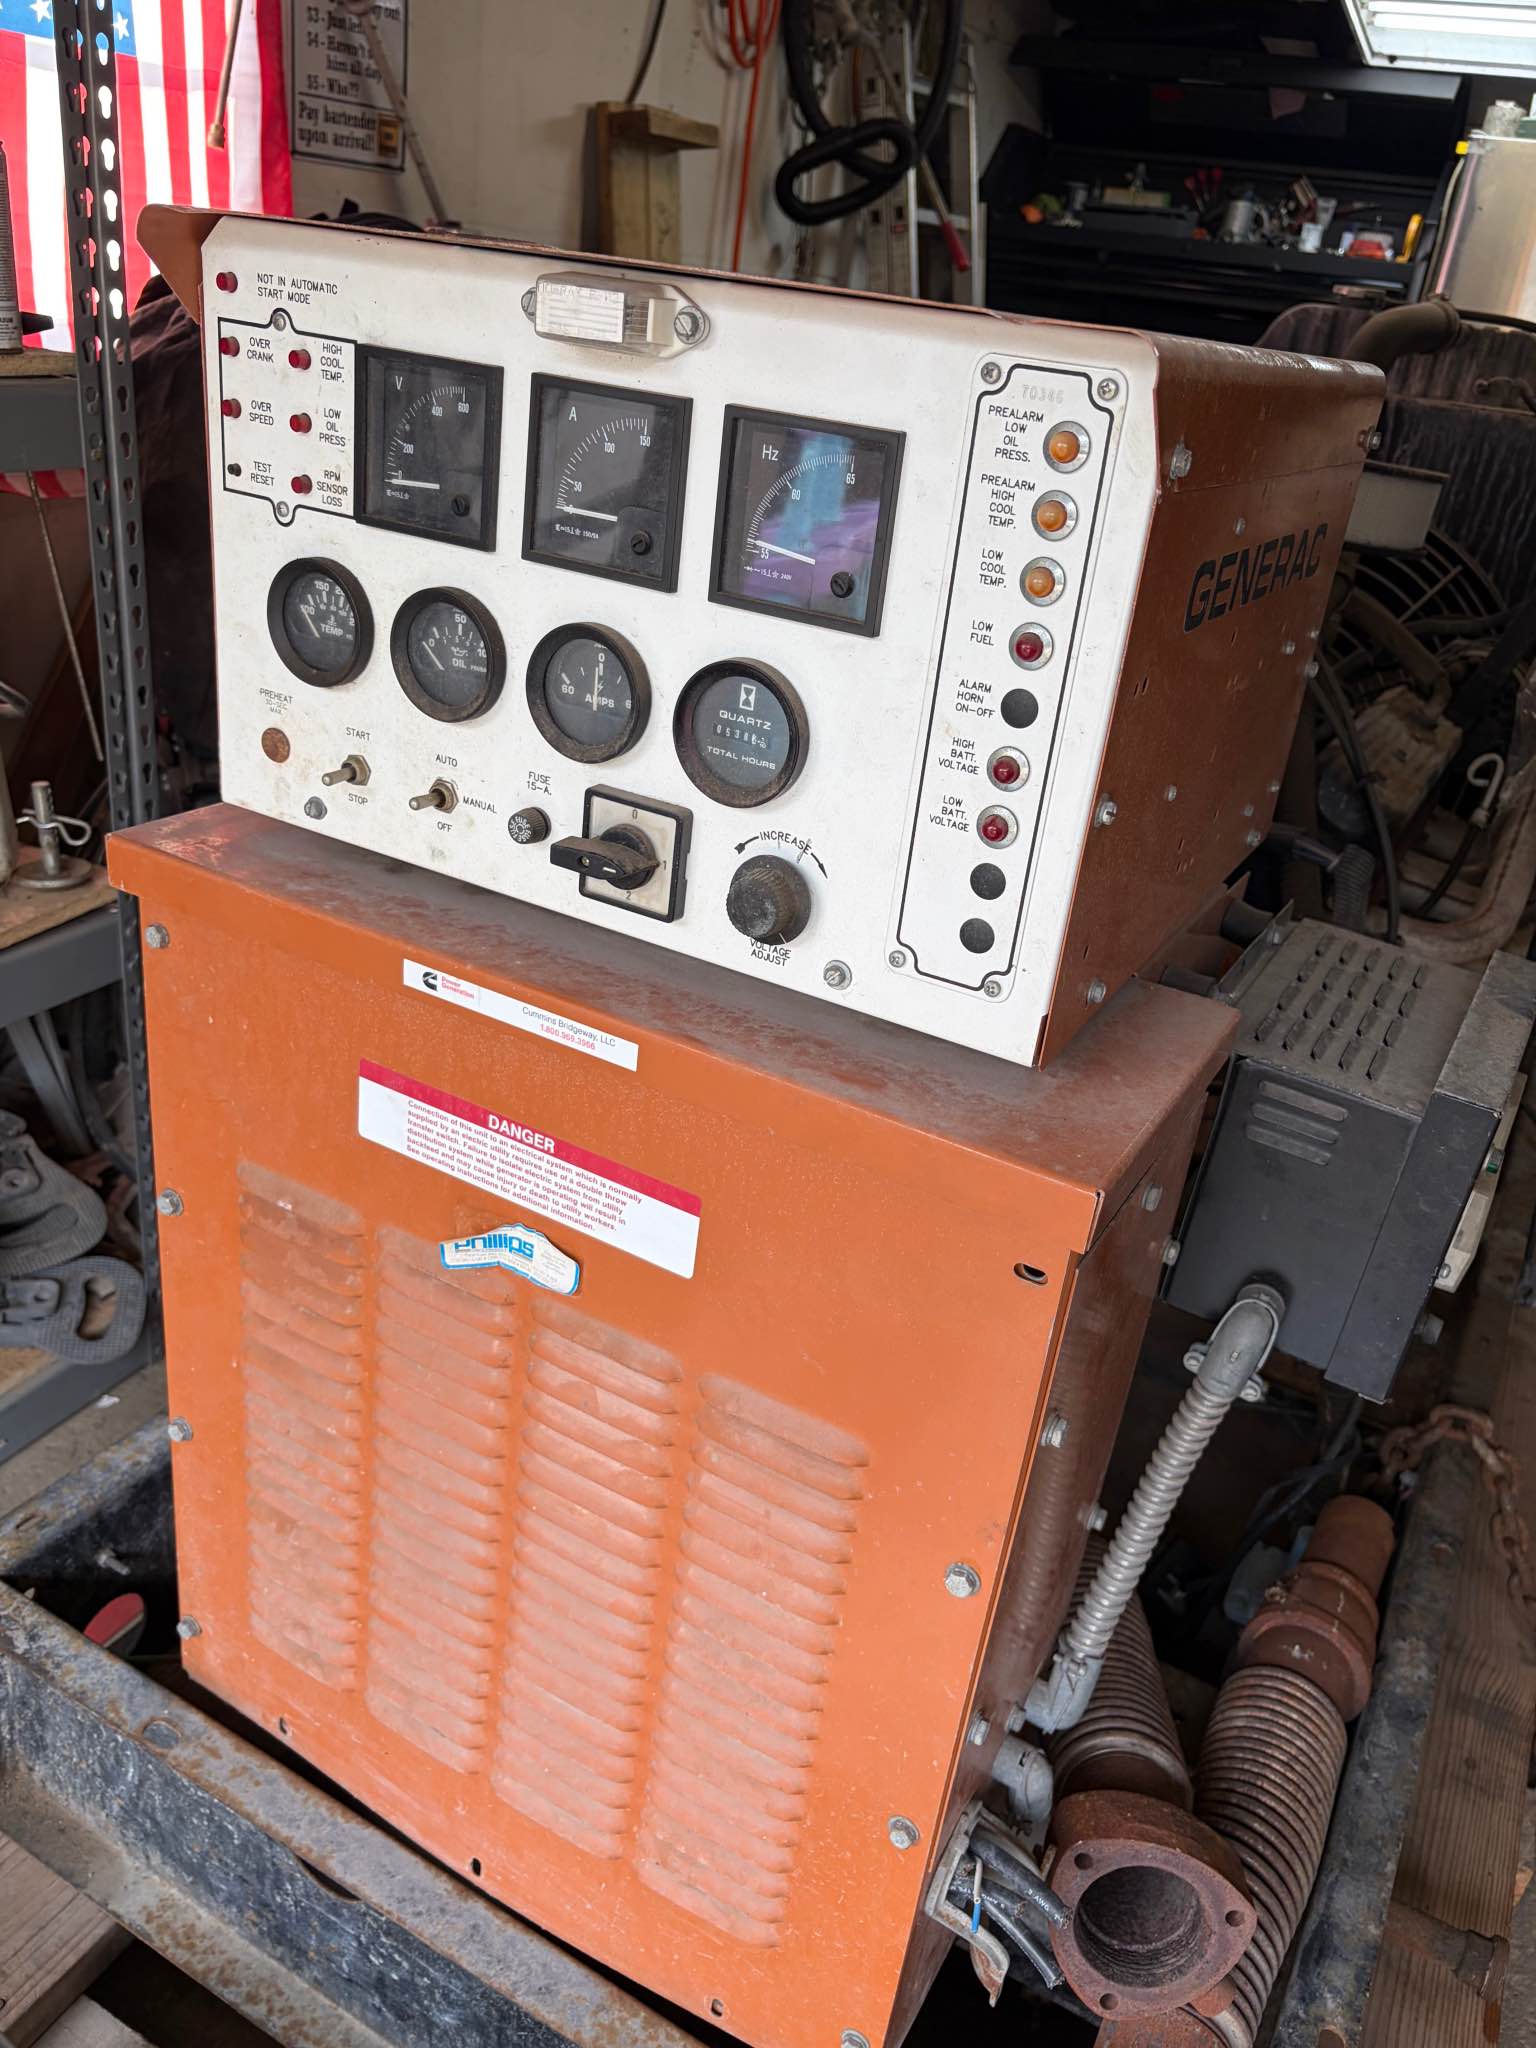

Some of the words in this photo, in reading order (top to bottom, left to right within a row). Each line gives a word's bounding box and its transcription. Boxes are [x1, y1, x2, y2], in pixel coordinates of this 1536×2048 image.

[298, 100, 320, 126] Pay
[324, 104, 376, 130] bartender
[298, 127, 328, 147] upon
[256, 272, 274, 285] NOT
[278, 276, 286, 287] IN
[290, 277, 338, 295] AUTOMATIC
[258, 287, 284, 301] START
[288, 292, 311, 305] MODE
[250, 336, 270, 350] OVER
[322, 343, 342, 355] HIGH
[246, 350, 274, 363] CRANK
[320, 369, 344, 383] TEMP.
[395, 376, 403, 391] V
[251, 400, 272, 413] OVER
[432, 406, 443, 417] 400
[250, 412, 274, 426] SPEED
[324, 408, 342, 420] LOW
[569, 406, 577, 422] A
[988, 405, 1044, 423] PREALARM
[326, 421, 339, 432] OIL
[1005, 422, 1027, 434] LOW
[320, 432, 346, 447] PRESS
[640, 435, 650, 447] 150
[1004, 435, 1019, 447] OIL
[403, 443, 414, 454] 200
[604, 442, 615, 454] 100
[762, 444, 779, 462] Hz
[994, 448, 1031, 462] PRESS.
[253, 461, 272, 473] TEST
[251, 473, 275, 486] RESET
[324, 470, 341, 482] RPM
[846, 472, 856, 485] 65
[981, 474, 1035, 492] PREALARM
[316, 481, 348, 496] SENSOR
[574, 481, 582, 493] 50
[791, 488, 800, 500] 60
[322, 494, 343, 508] LOSS
[991, 489, 1015, 502] HIGH
[990, 502, 1016, 515] COOL
[988, 515, 1016, 530] TEMP.
[760, 548, 769, 560] 55
[982, 548, 1003, 560] LOW
[980, 561, 1006, 575] COOL
[979, 574, 1006, 588] TEMP.
[1184, 523, 1328, 633] GENERAC
[314, 580, 330, 591] 150
[454, 613, 467, 624] 50
[321, 623, 343, 636] TEMP
[972, 620, 993, 632] LOW
[429, 638, 435, 647] 0
[970, 632, 994, 646] FUEL
[452, 658, 467, 669] OIL
[598, 653, 605, 662] 0
[561, 684, 574, 695] 60
[959, 679, 992, 694] ALARM
[260, 687, 293, 704] PREHEAT
[957, 690, 984, 704] HORN
[955, 703, 995, 718] ON-OFF
[719, 710, 771, 730] QUARTZ
[346, 727, 370, 741] START
[952, 737, 975, 750] HIGH
[436, 754, 458, 767] AUTO
[706, 746, 738, 760] TOTAL
[742, 755, 776, 770] HOURS
[950, 749, 977, 763] BATT.
[938, 757, 980, 775] VOLTAGE
[528, 771, 551, 785] FUSE
[527, 781, 552, 796] 15-A.
[348, 793, 368, 806] STOP
[463, 796, 497, 814] MANUAL
[943, 795, 963, 808] LOW
[632, 809, 638, 819] 0
[941, 807, 967, 821] BATT.
[437, 821, 452, 832] OFF
[929, 815, 970, 832] VOLTAGE
[760, 830, 812, 855] INCREASE
[663, 861, 667, 870] 1
[625, 891, 632, 900] 2
[750, 939, 791, 959] VOLTAGE
[750, 950, 787, 967] ADJUST
[441, 976, 461, 988] Power
[441, 983, 474, 999] Generation
[522, 1006, 556, 1026] Cummins
[558, 1019, 598, 1042] Bridgeway,
[600, 1034, 616, 1047] LLC
[488, 1114, 555, 1153] DANGER
[408, 1111, 438, 1126] supplied
[441, 1123, 448, 1132] by
[462, 1133, 488, 1148] electric
[490, 1144, 510, 1158] utility
[512, 1155, 542, 1170] requires
[544, 1168, 557, 1177] use
[576, 1181, 603, 1196] double
[605, 1192, 627, 1206] throw
[409, 1100, 448, 1122] Connection
[460, 1122, 472, 1132] this
[474, 1128, 488, 1138] unit
[511, 1144, 544, 1162] electrical
[547, 1159, 572, 1174] system
[576, 1171, 598, 1184] which
[609, 1185, 642, 1204] normally
[408, 1119, 434, 1134] transfer
[436, 1132, 460, 1146] switch.
[464, 1142, 488, 1157] Failure
[498, 1157, 522, 1171] isolate
[525, 1169, 552, 1184] electric
[555, 1181, 580, 1197] system
[583, 1192, 600, 1204] from
[602, 1201, 623, 1215] utility
[408, 1128, 446, 1148] distribution
[449, 1145, 473, 1160] system
[476, 1156, 494, 1169] while
[497, 1166, 532, 1184] generator
[542, 1185, 578, 1206] operating
[581, 1201, 593, 1212] will
[595, 1207, 616, 1221] result
[407, 1136, 439, 1154] backfeed
[441, 1151, 454, 1161] and
[457, 1158, 471, 1169] may
[474, 1165, 494, 1178] cause
[496, 1174, 517, 1189] injury
[529, 1189, 550, 1202] death
[552, 1198, 559, 1206] to
[562, 1203, 581, 1216] utility
[584, 1212, 617, 1231] workers.
[407, 1145, 420, 1155] See
[422, 1152, 455, 1171] operating
[457, 1167, 498, 1190] instructions
[500, 1186, 510, 1194] for
[512, 1192, 549, 1212] additional
[551, 1207, 595, 1231] information.
[1034, 1895, 1049, 1912] AWG
